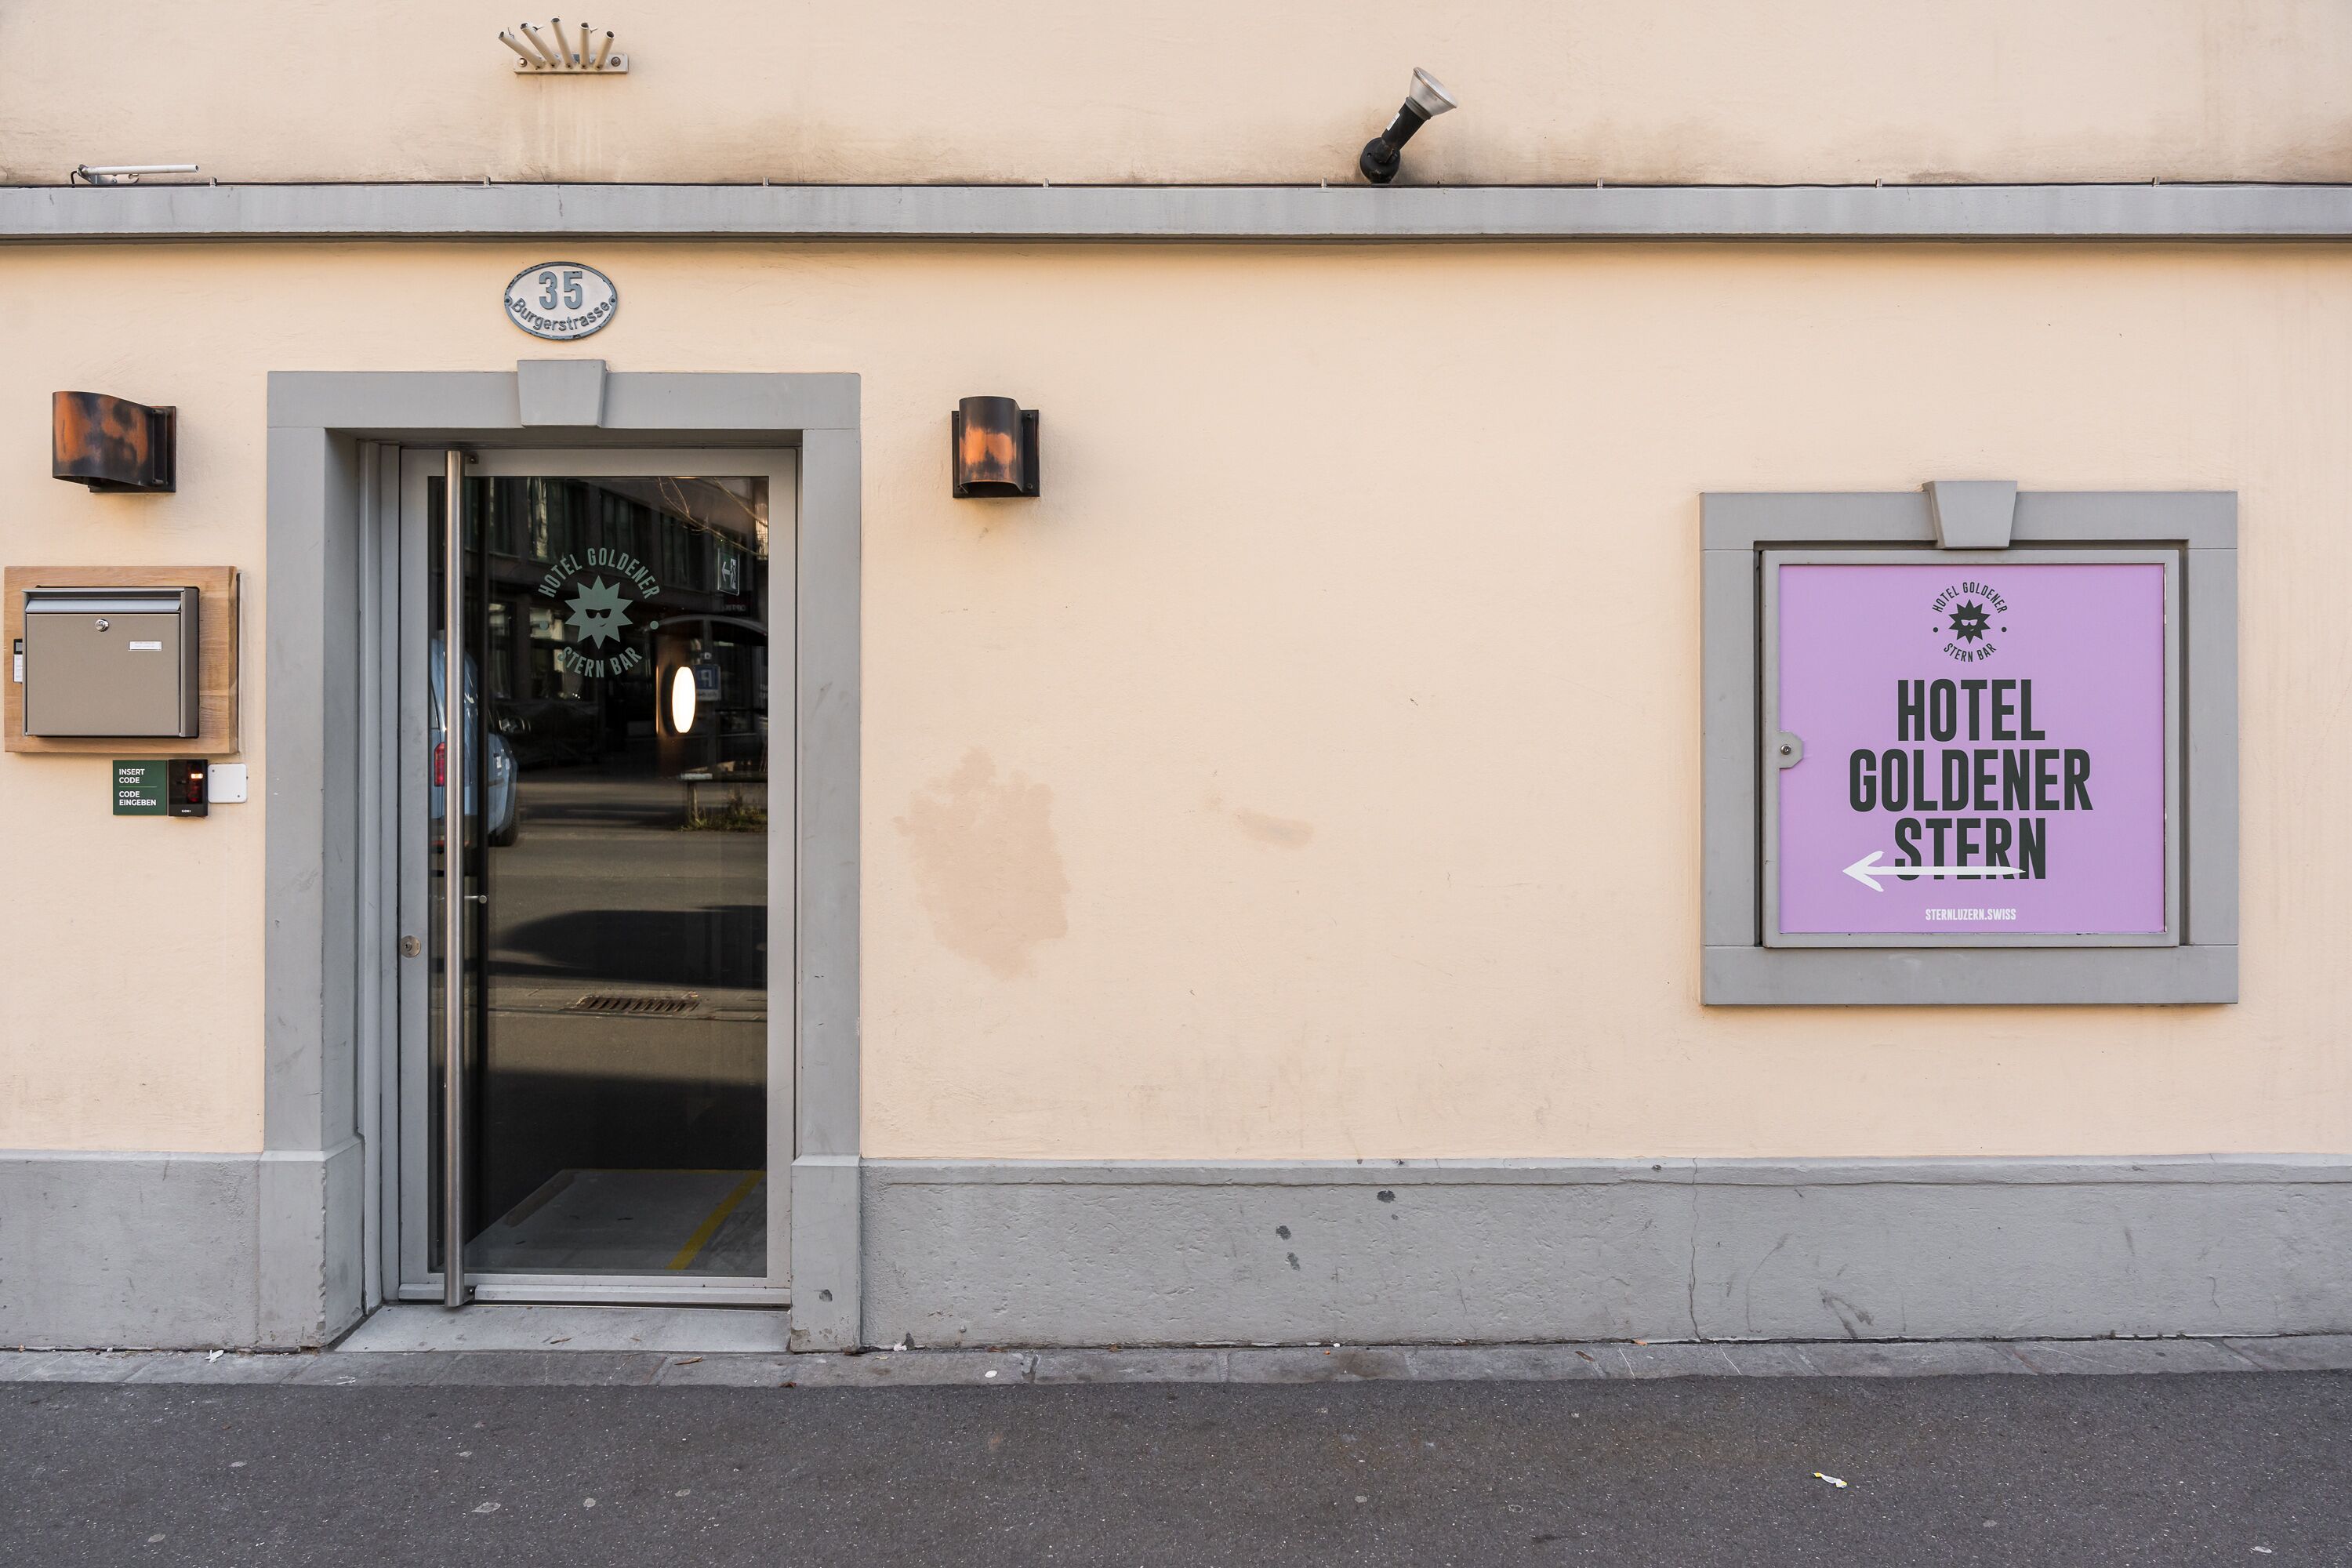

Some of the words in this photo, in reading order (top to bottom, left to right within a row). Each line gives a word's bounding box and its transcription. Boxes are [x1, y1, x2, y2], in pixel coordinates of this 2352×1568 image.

[539, 270, 583, 310] 35
[510, 297, 610, 331] Burgerstrasse
[538, 554, 583, 597] HOTEL
[587, 547, 660, 599] GOLDENER
[1932, 585, 1960, 612] HOTEL
[1962, 582, 2008, 613] GOLDENER
[557, 646, 604, 678] STERN
[610, 647, 643, 675] BAR
[1944, 643, 1973, 662] STERN
[1976, 643, 1997, 660] BAR
[1897, 678, 2045, 742] HOTEL
[1849, 748, 2093, 812] GOLDENER
[1894, 817, 2046, 880] STERN
[1925, 908, 2016, 920] STERNLUZERN.SWISS
